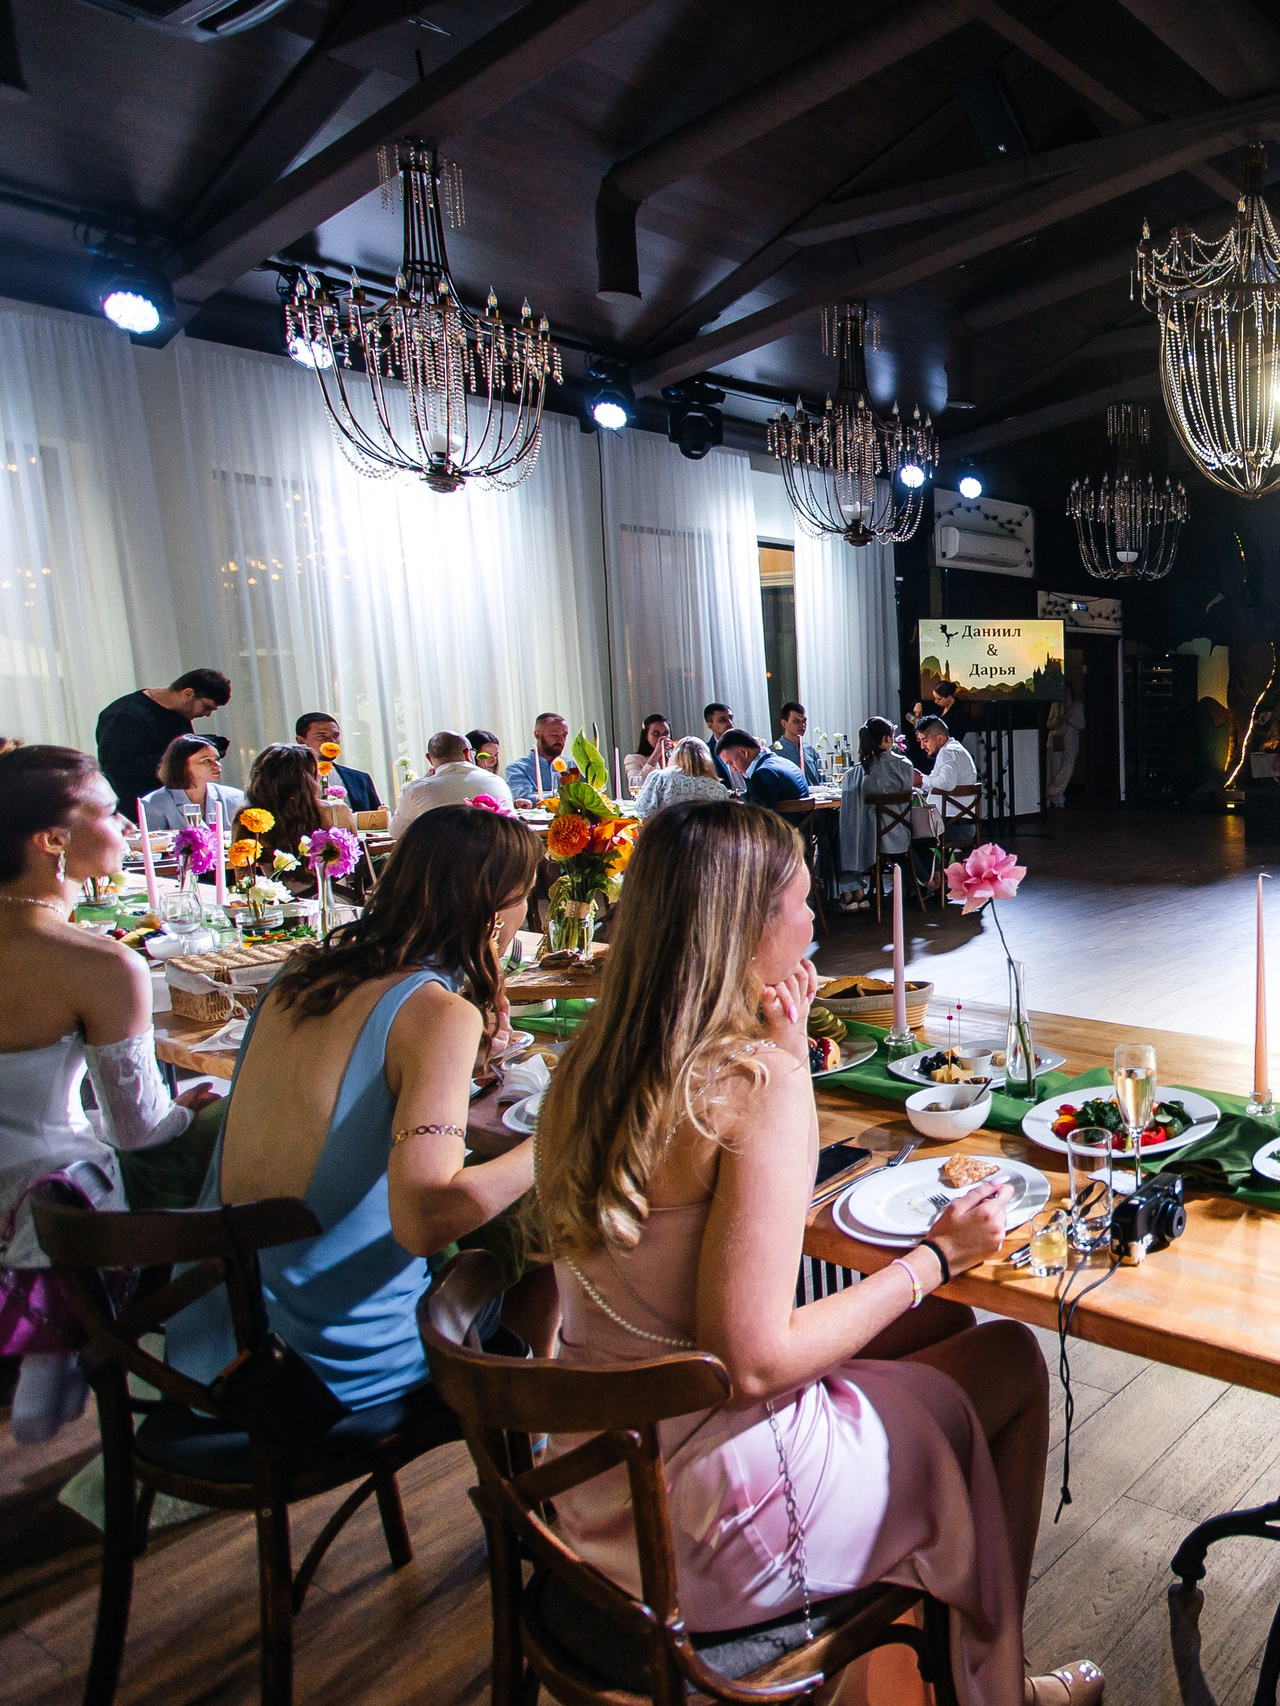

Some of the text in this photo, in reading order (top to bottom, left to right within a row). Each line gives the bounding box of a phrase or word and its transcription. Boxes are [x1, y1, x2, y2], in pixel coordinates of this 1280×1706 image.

[962, 625, 1021, 639] Даниил
[987, 643, 998, 656] &
[969, 664, 1016, 678] Дарья
